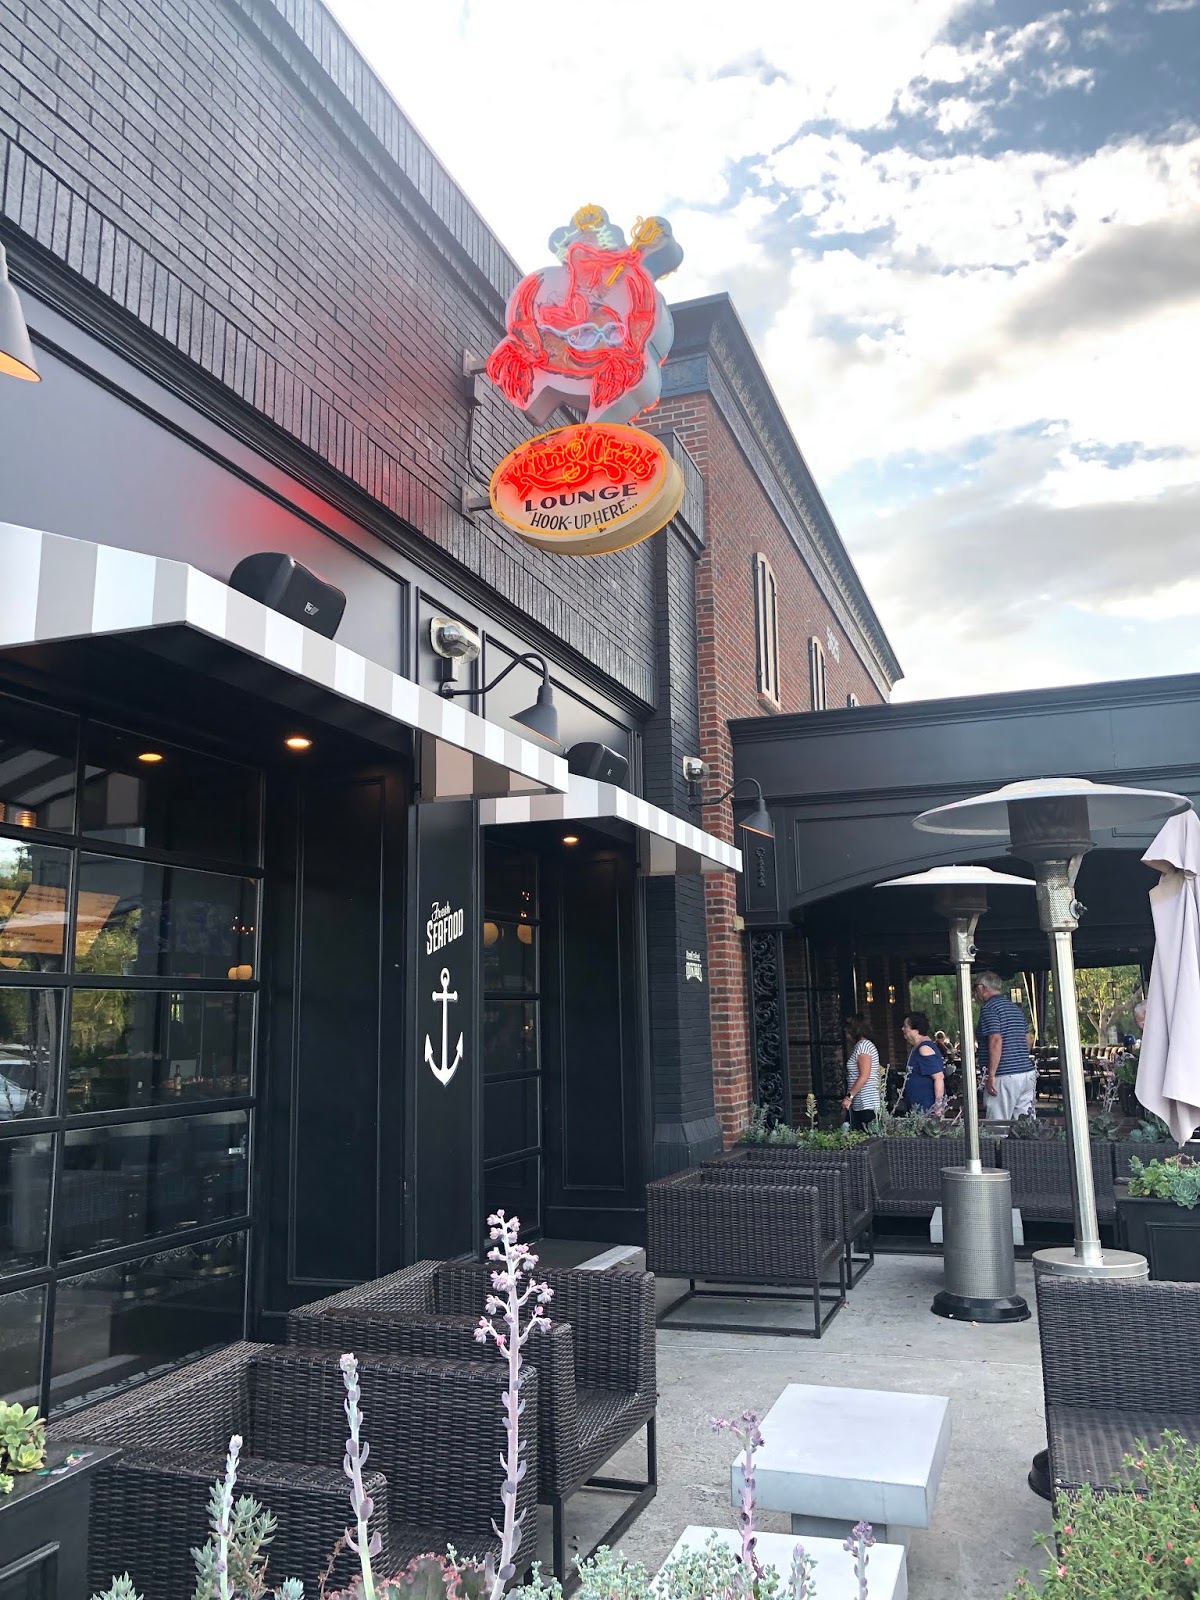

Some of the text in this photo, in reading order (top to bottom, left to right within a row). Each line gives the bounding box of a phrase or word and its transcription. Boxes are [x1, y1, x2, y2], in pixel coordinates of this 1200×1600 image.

[525, 483, 638, 512] LOUNGE
[431, 901, 451, 921] Fresh
[427, 908, 464, 955] SEAFOOD
